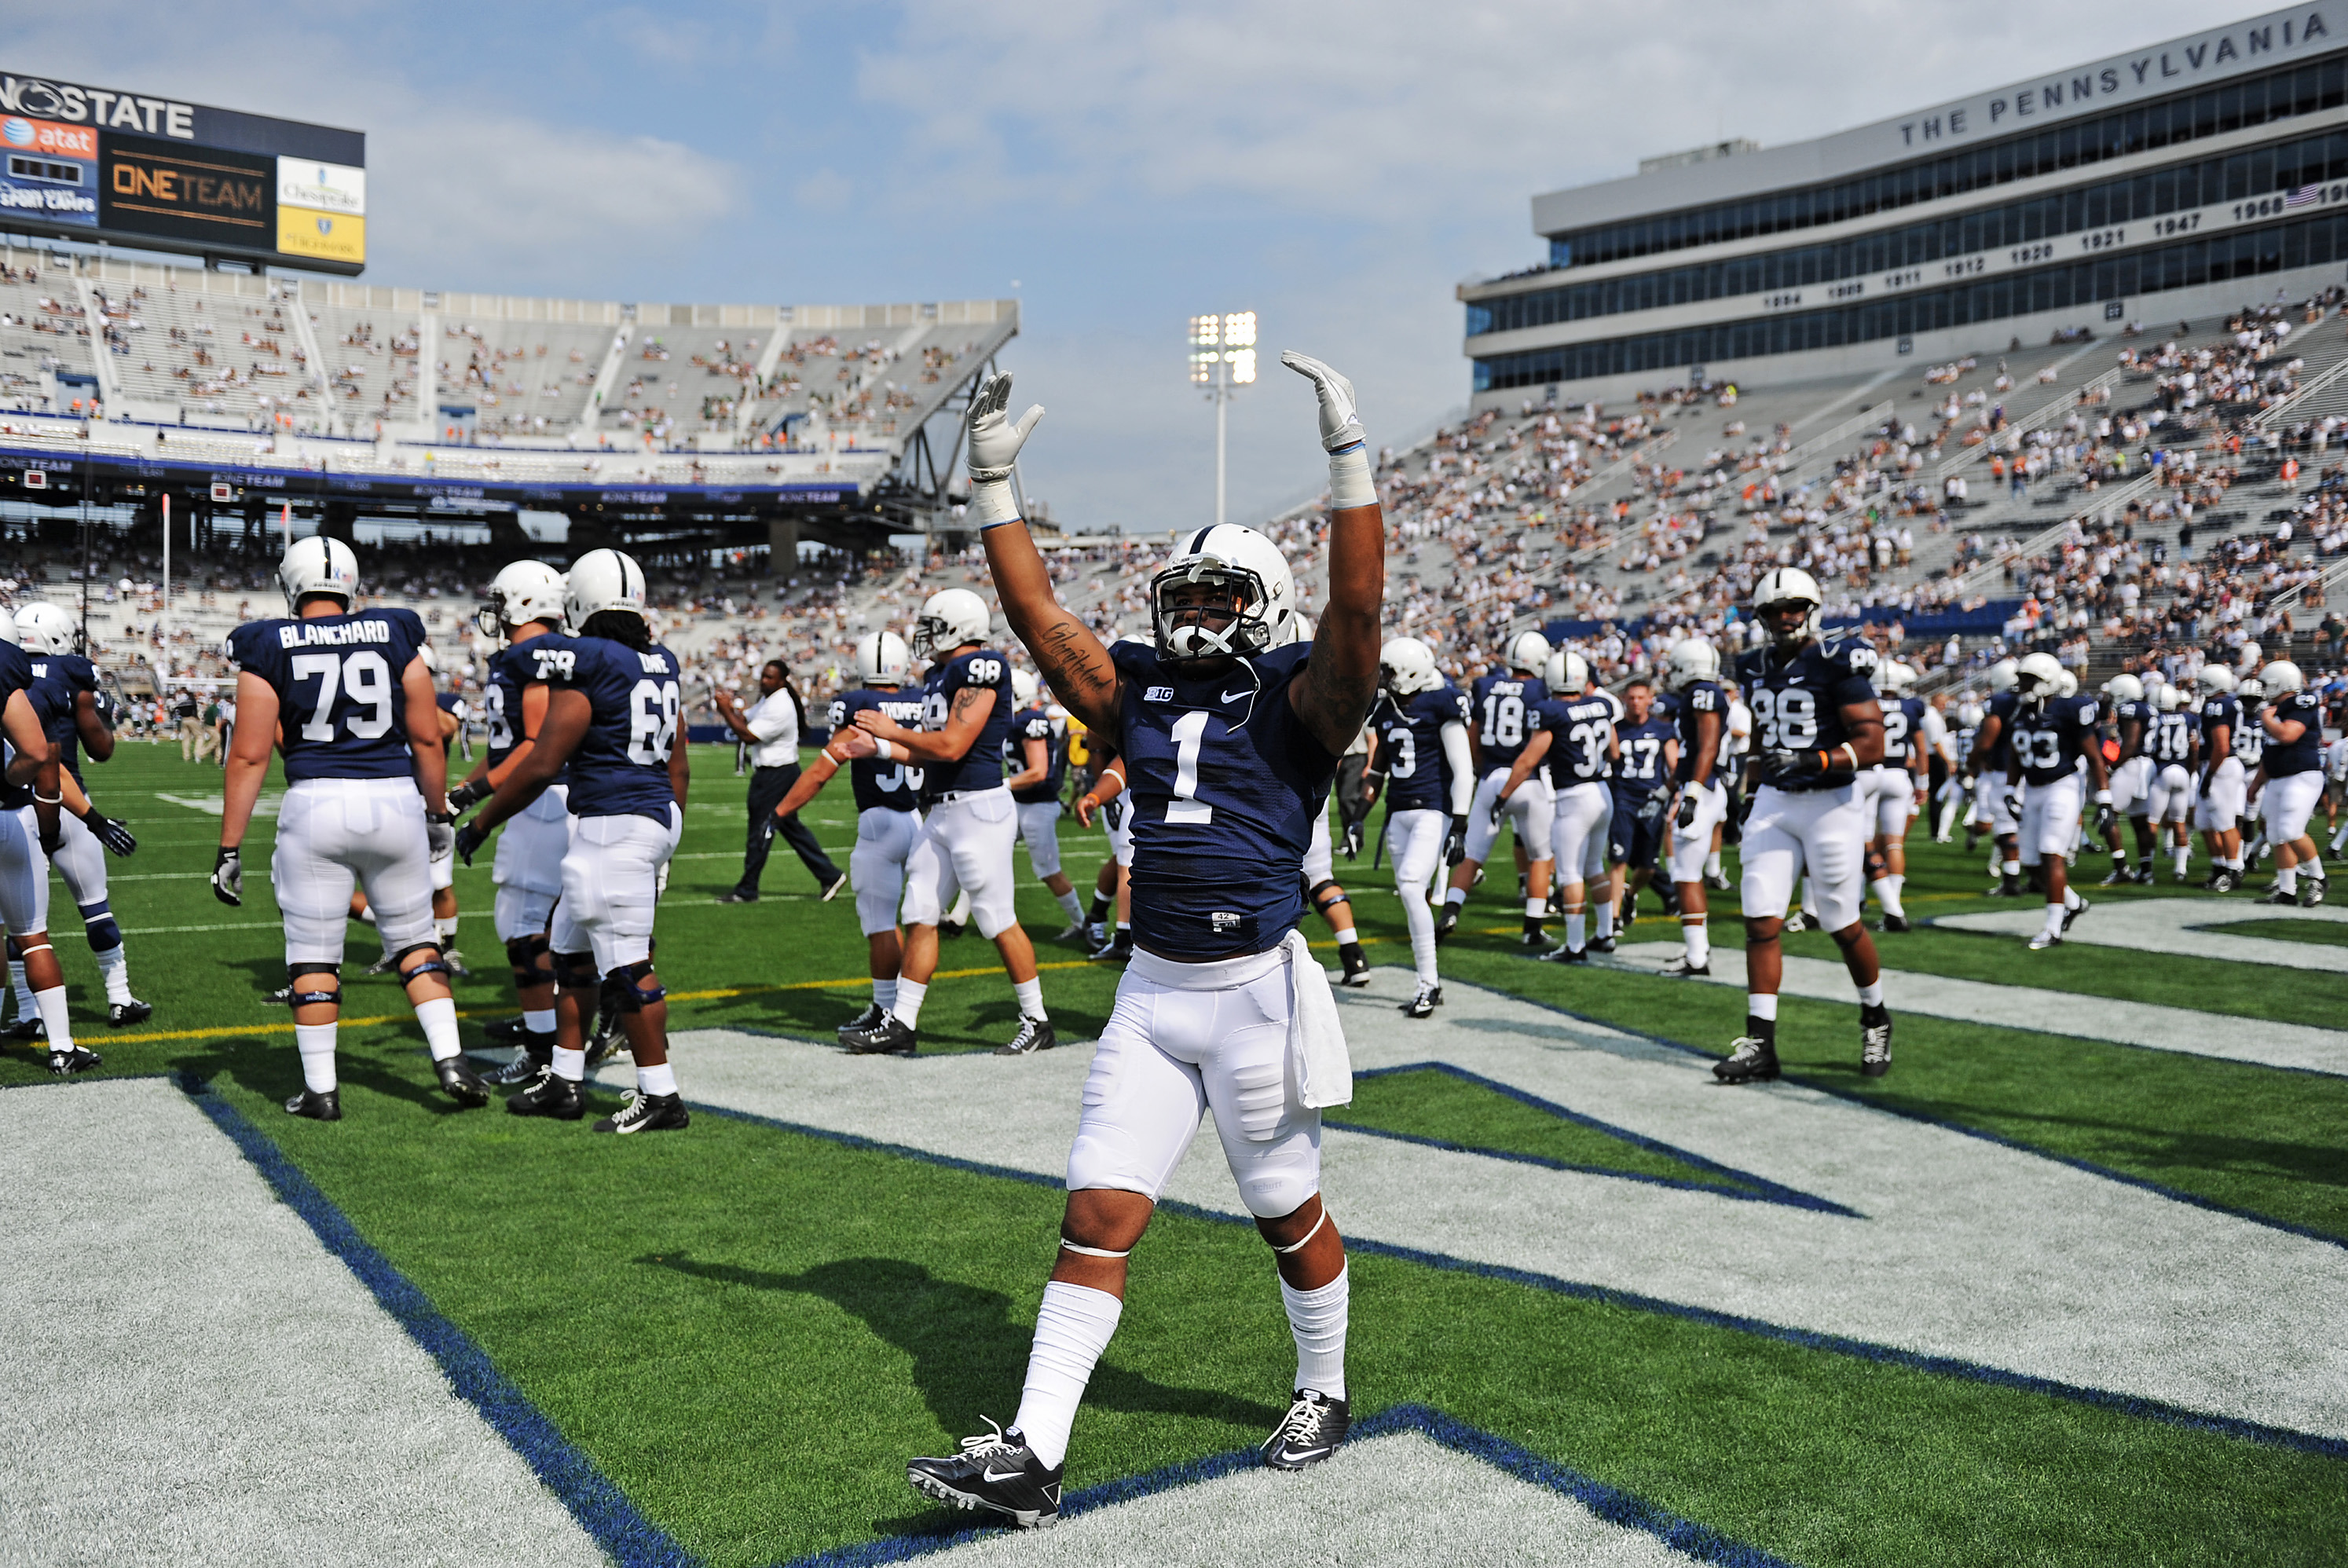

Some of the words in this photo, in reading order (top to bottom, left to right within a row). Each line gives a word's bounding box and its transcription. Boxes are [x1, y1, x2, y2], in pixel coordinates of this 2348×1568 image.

[1899, 108, 1967, 146] THE
[1989, 12, 2328, 123] PENNSYLVANIA
[60, 86, 195, 140] STATE
[39, 126, 91, 152] at&t
[2319, 183, 2348, 204] 19
[2155, 213, 2201, 236] 1947
[1945, 257, 1984, 276] 1912
[279, 621, 390, 649] BLANCHARD
[968, 658, 1002, 684] 98
[291, 650, 393, 742] 79
[877, 702, 925, 720] THOMPS
[1692, 689, 1715, 711] 21
[1025, 718, 1049, 738] 45
[1481, 695, 1525, 747] 18
[1387, 727, 1416, 779] 3
[1570, 718, 1612, 778] 32
[1619, 738, 1660, 779] 17
[2012, 728, 2060, 768] 93
[2159, 724, 2189, 760] 14
[1164, 711, 1213, 824] 1
